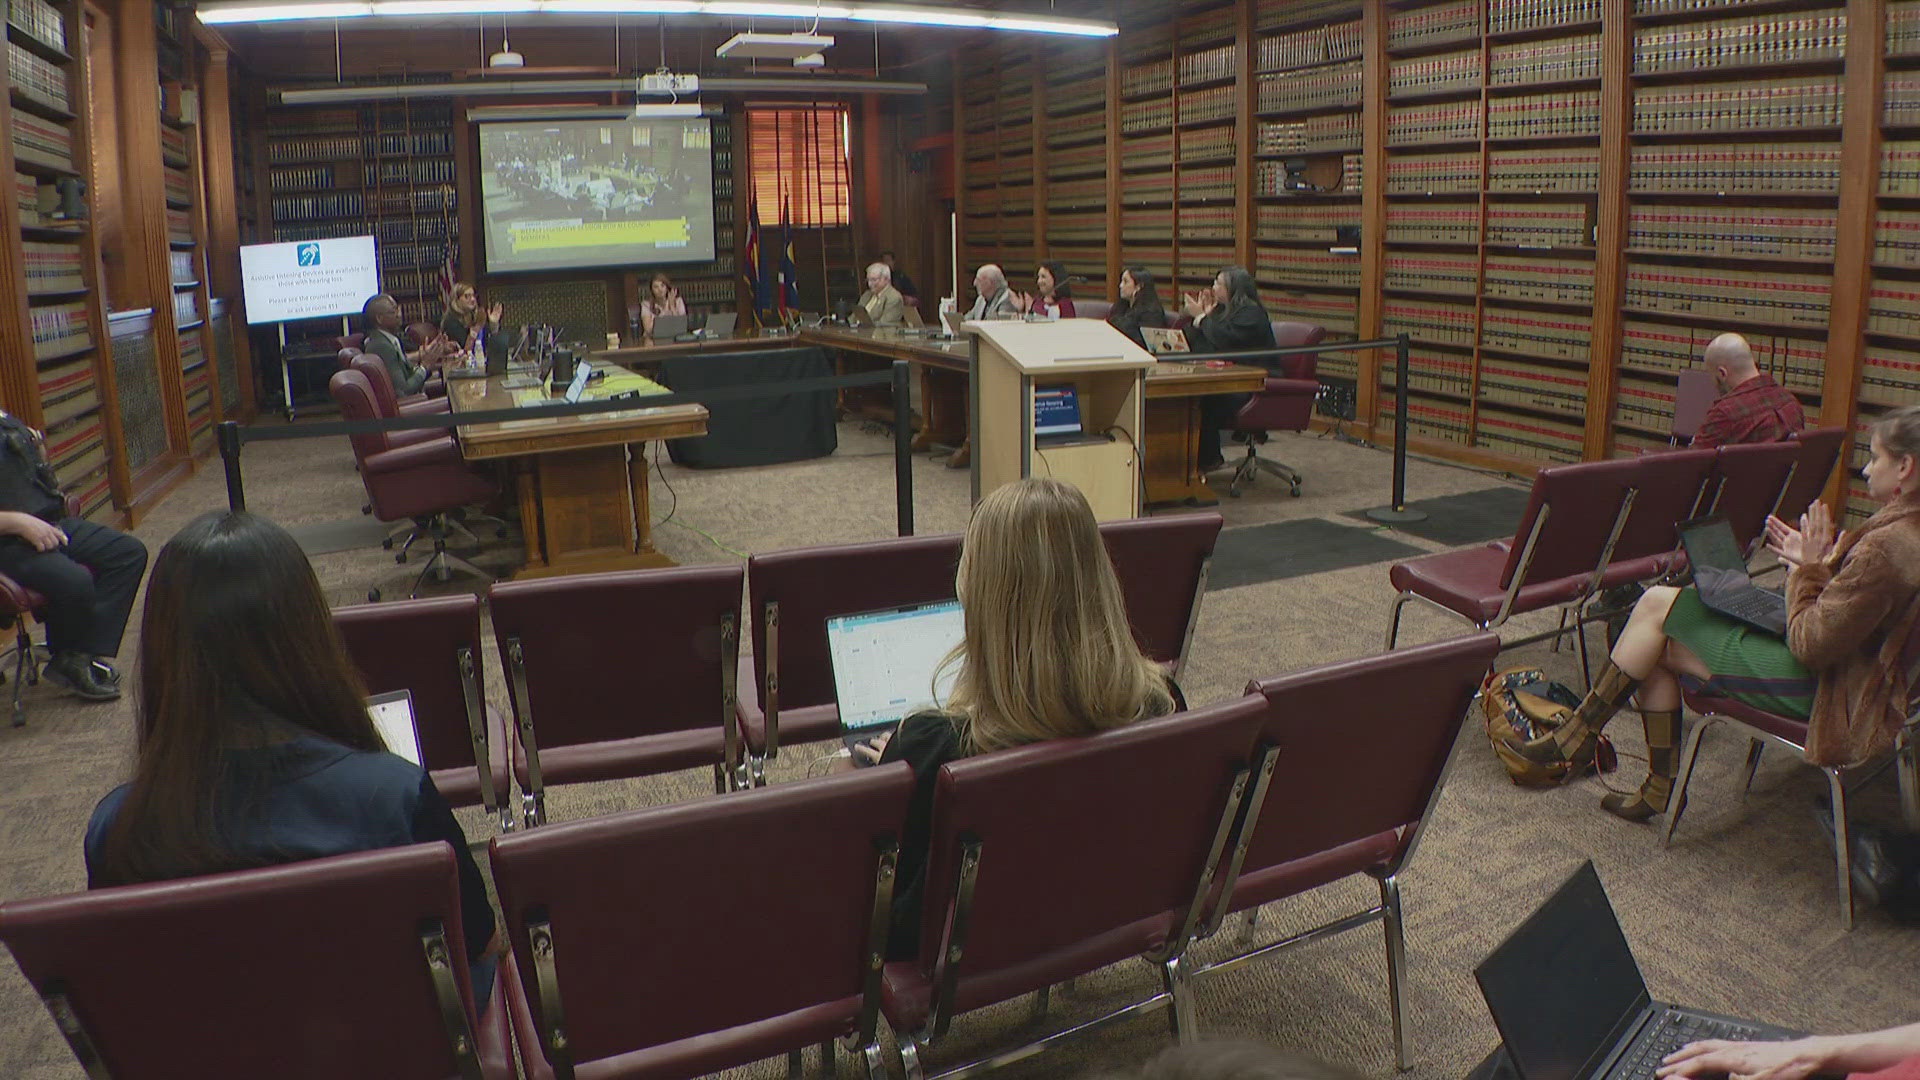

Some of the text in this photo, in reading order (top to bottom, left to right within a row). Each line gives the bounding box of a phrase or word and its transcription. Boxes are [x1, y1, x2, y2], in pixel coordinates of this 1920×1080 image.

[276, 272, 301, 280] Listening
[302, 270, 324, 278] Devices
[335, 266, 360, 274] available
[309, 277, 330, 285] hearing
[268, 297, 287, 305] Please
[309, 292, 330, 300] council
[330, 290, 356, 299] secretary
